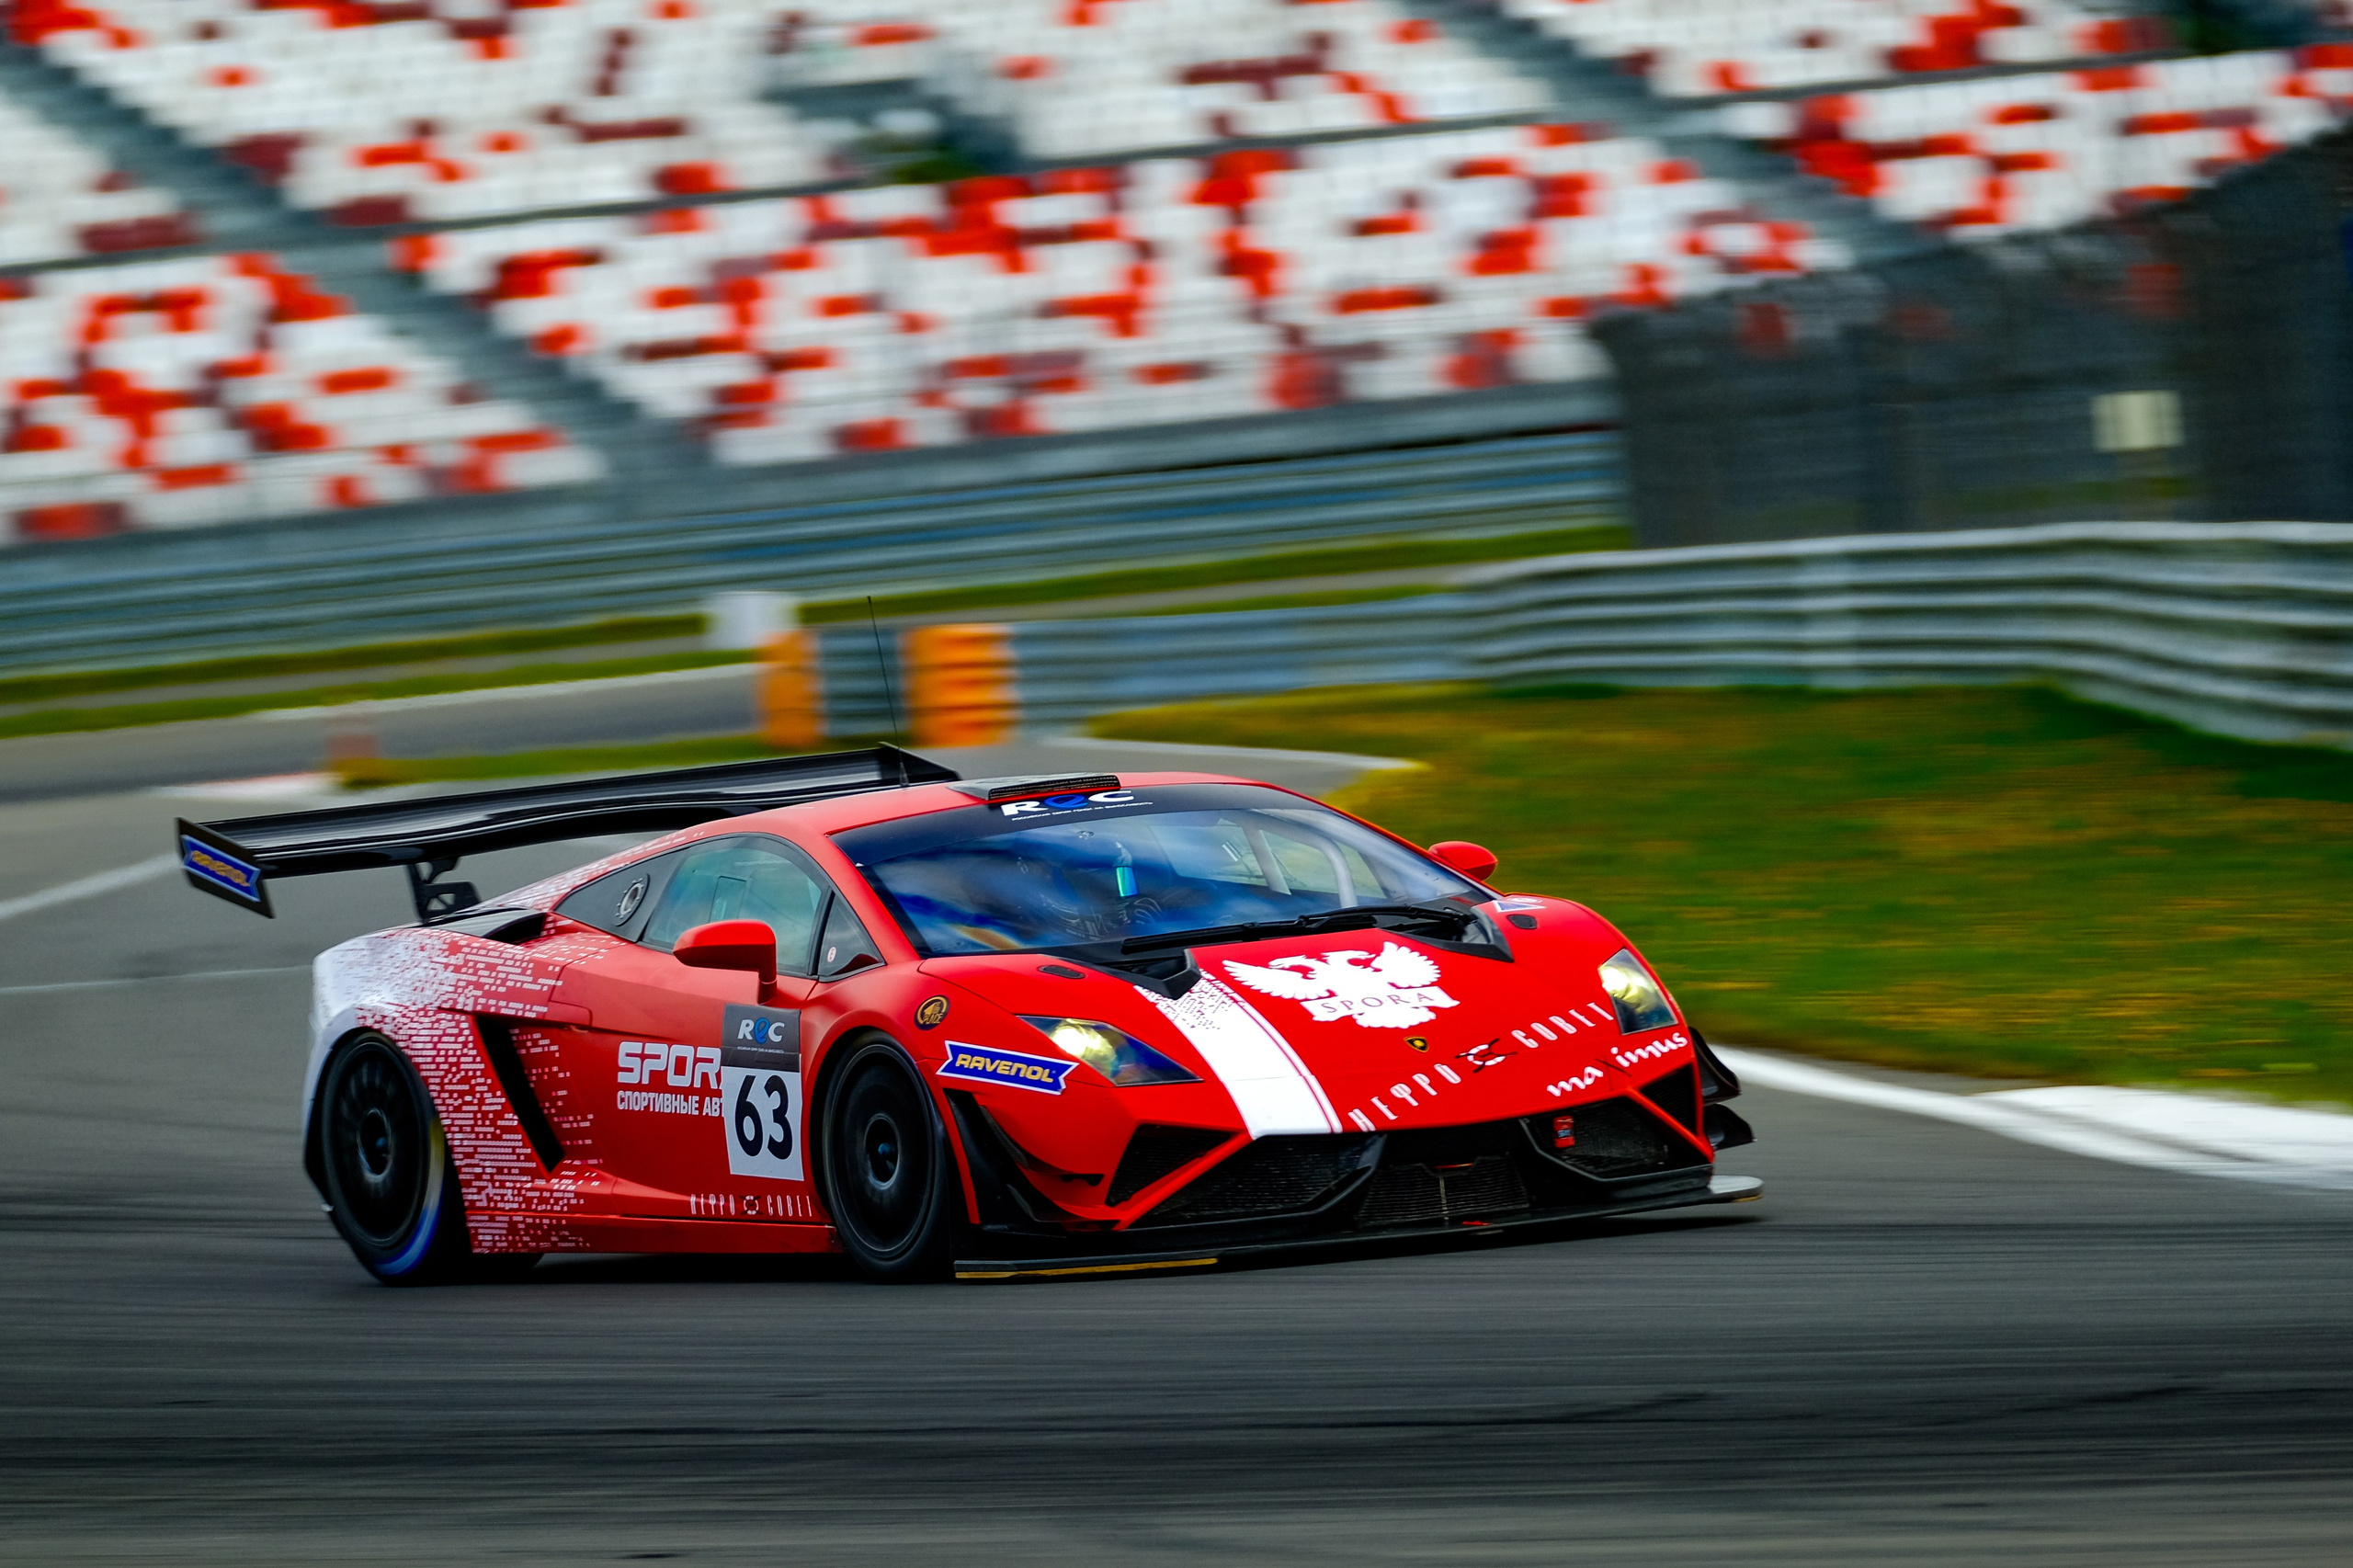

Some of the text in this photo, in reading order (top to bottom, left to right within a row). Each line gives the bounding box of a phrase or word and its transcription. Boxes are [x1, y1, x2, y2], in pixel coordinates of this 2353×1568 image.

[617, 1041, 722, 1089] SPOR
[955, 1053, 1054, 1083] RAVENOL
[617, 1090, 699, 1115] СПОРТИВНЫЕ
[735, 1074, 793, 1160] 63
